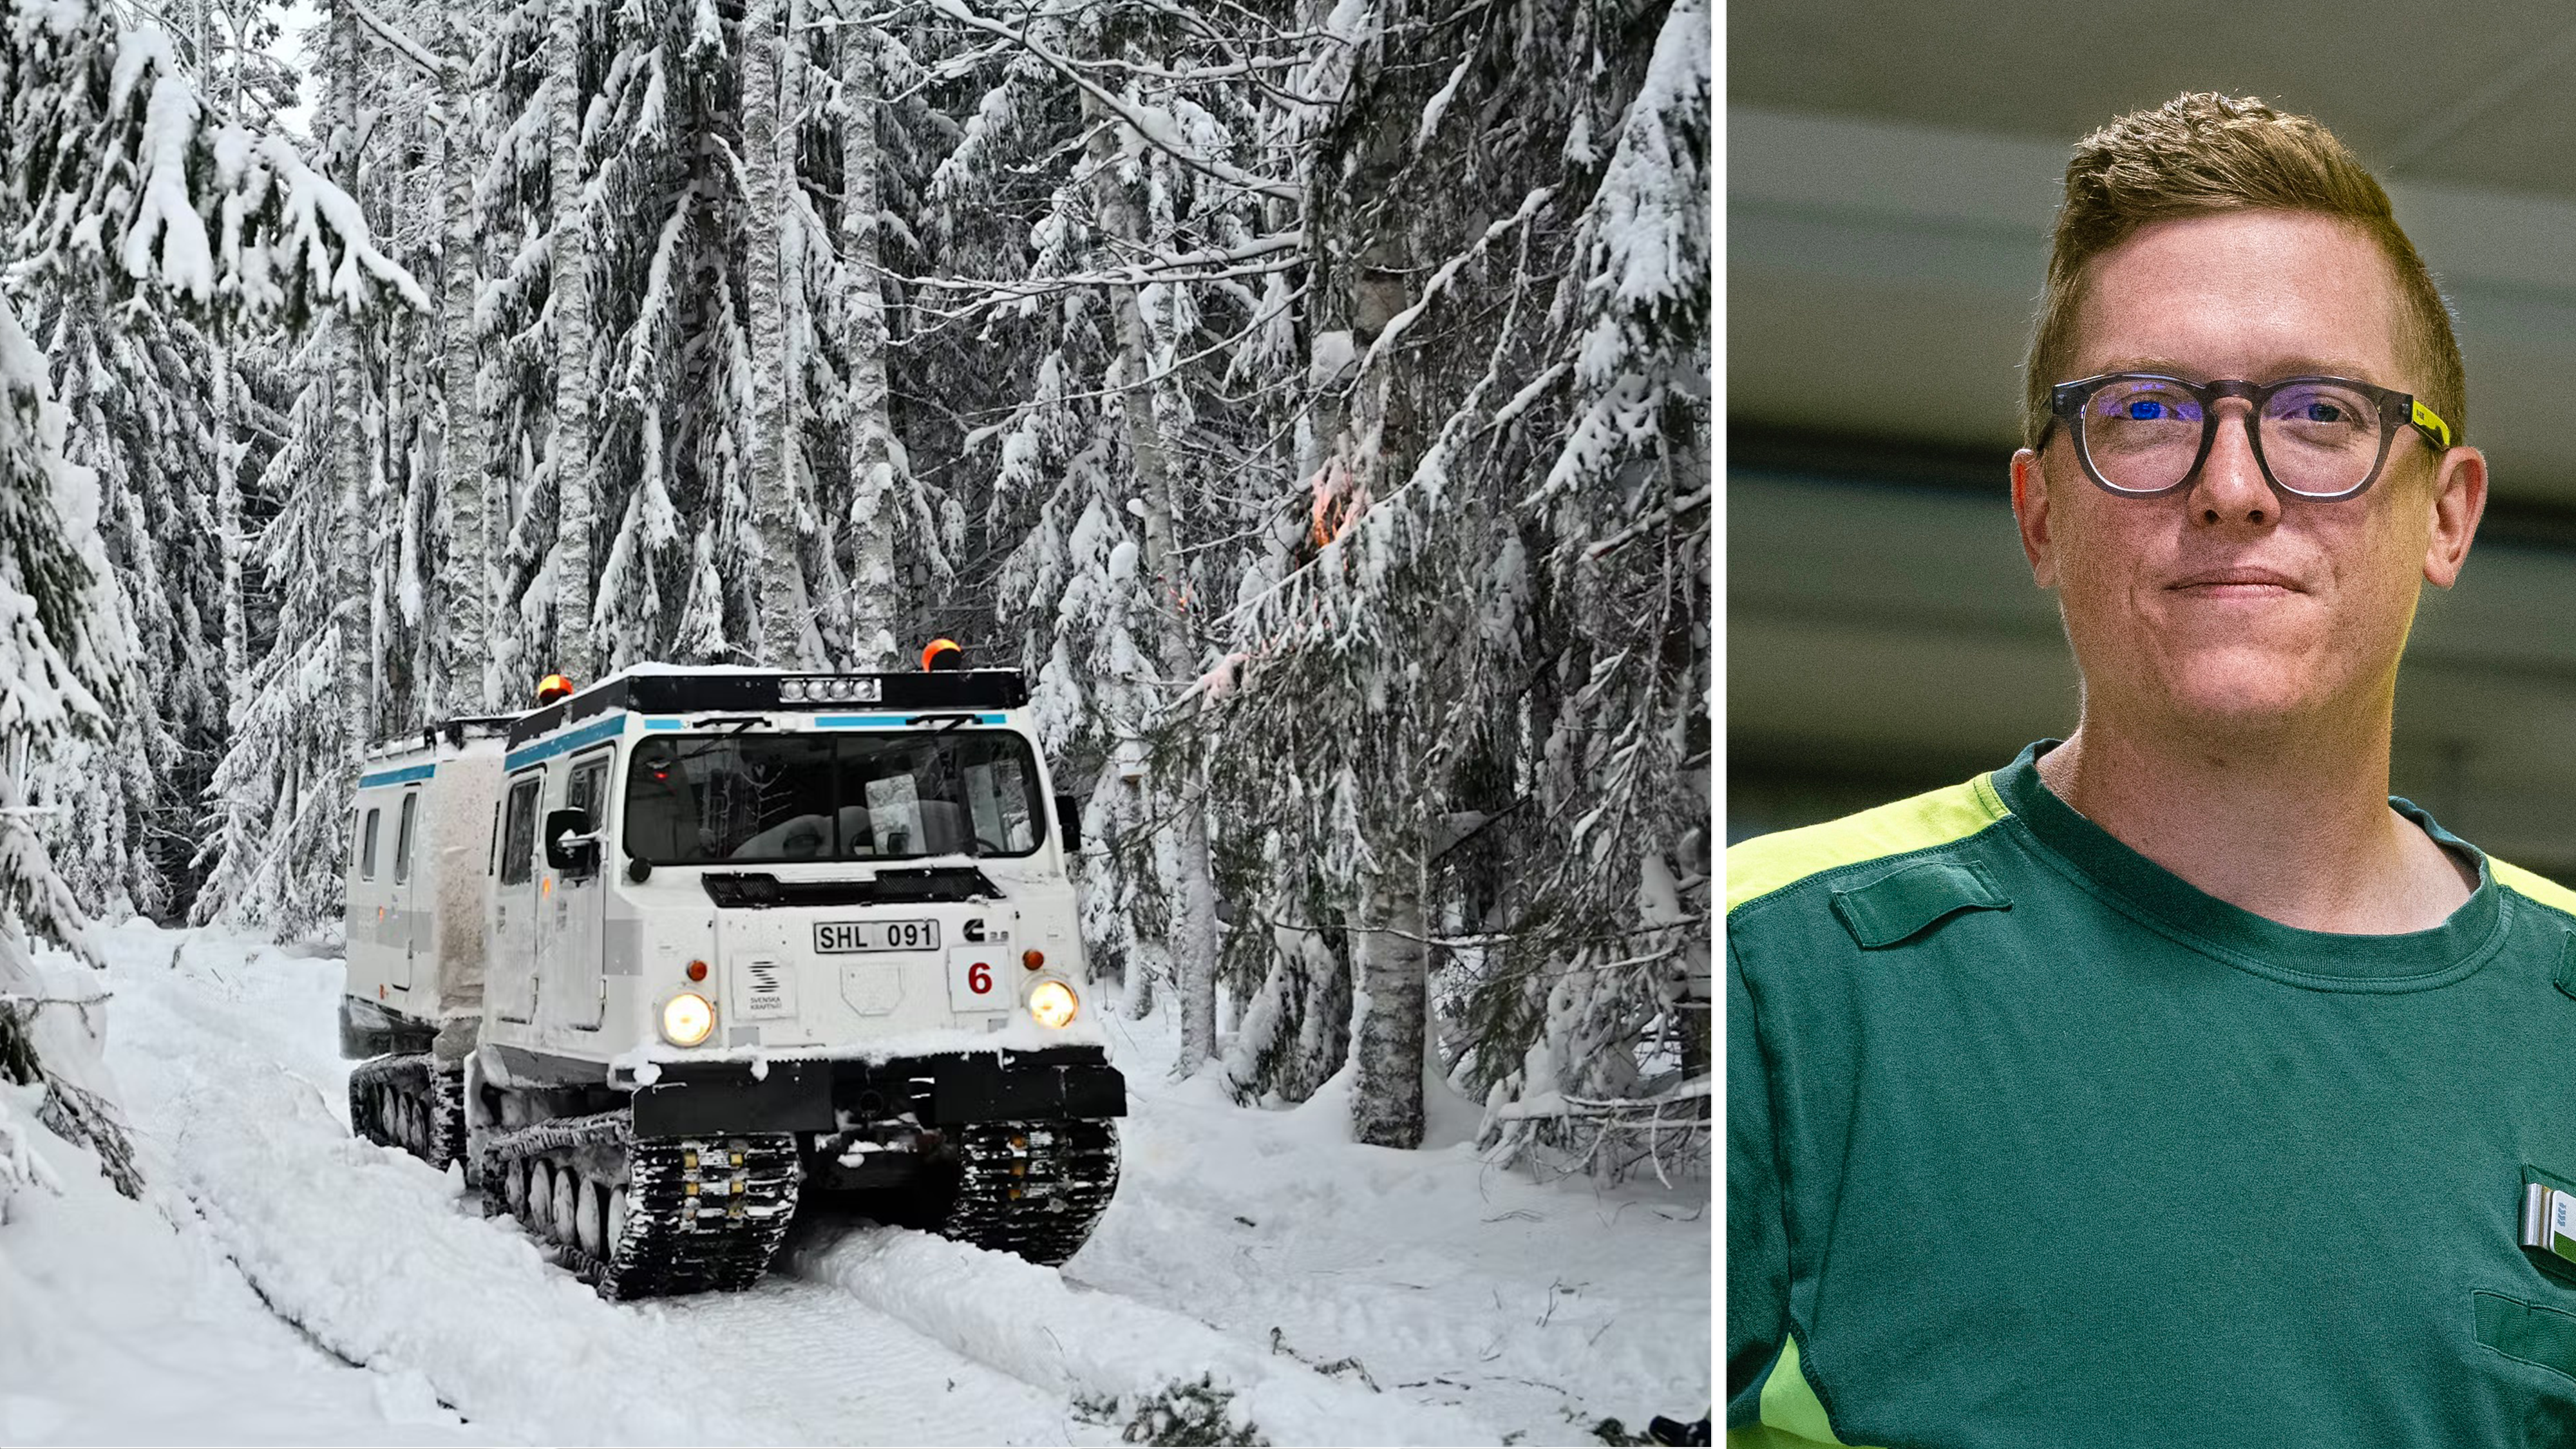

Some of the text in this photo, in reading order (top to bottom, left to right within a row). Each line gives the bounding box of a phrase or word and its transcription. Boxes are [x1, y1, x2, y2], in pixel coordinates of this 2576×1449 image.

[820, 924, 930, 949] SHL 091
[969, 962, 992, 994] 6
